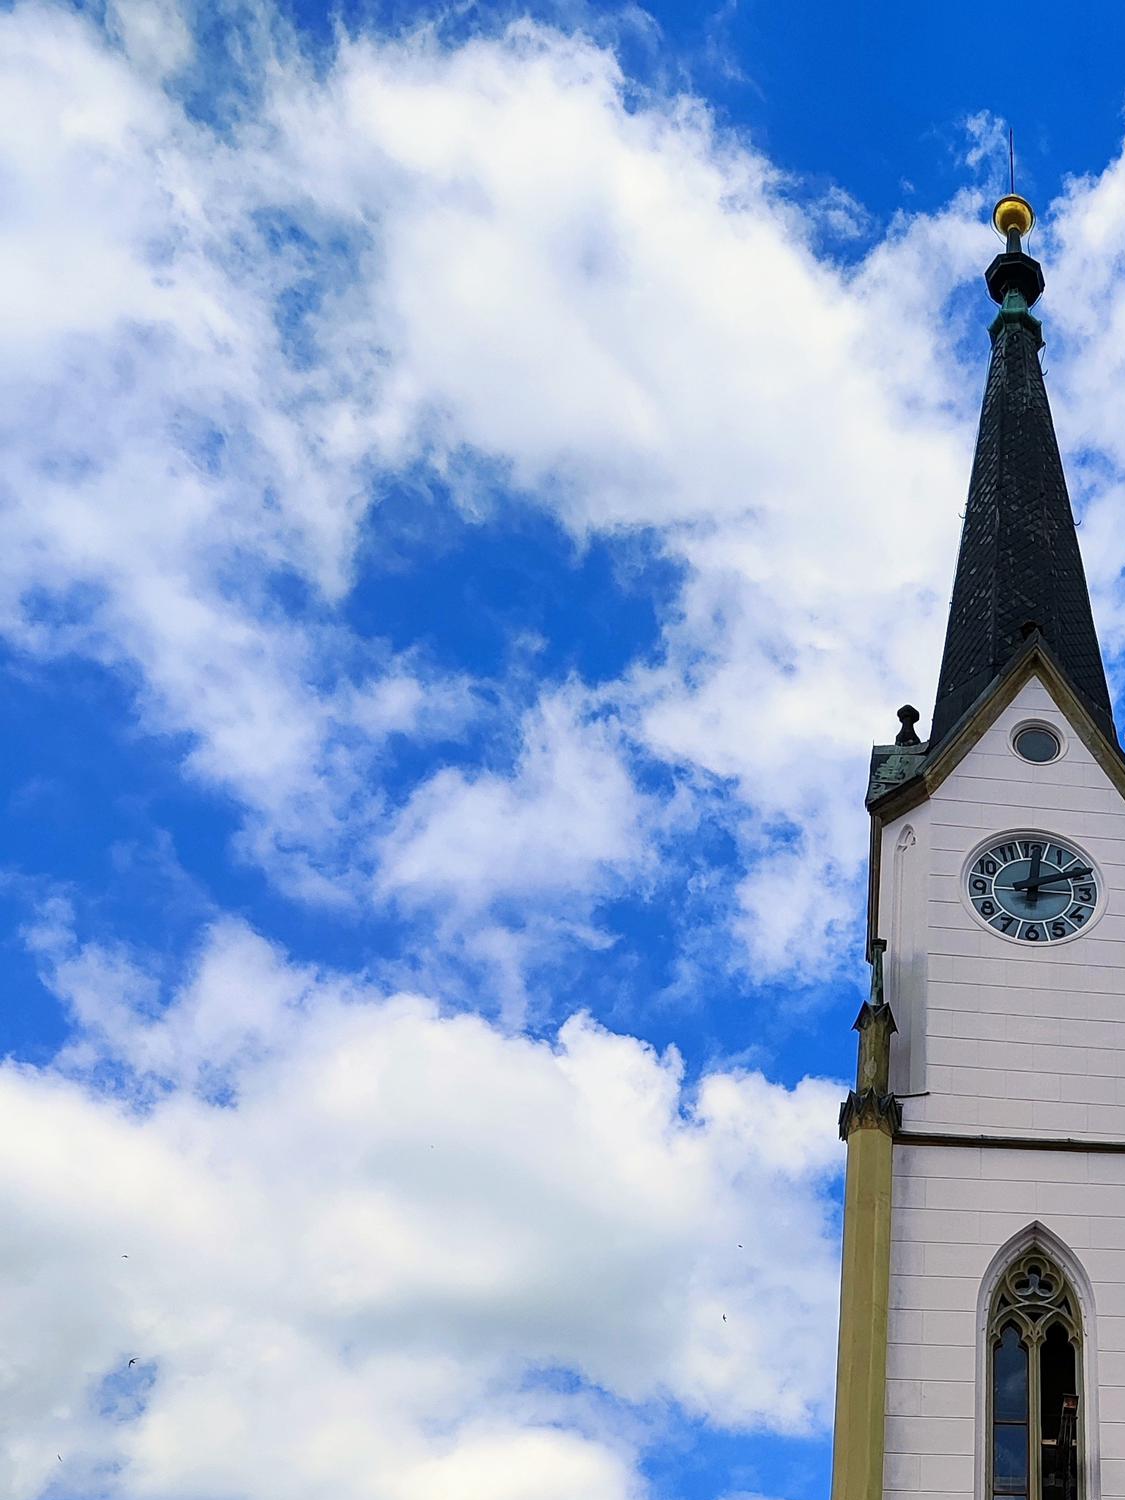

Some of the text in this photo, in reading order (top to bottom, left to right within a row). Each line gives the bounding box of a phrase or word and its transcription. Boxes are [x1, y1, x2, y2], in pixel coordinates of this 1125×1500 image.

[999, 845, 1015, 862] 11
[1056, 849, 1063, 865] 1
[978, 858, 996, 875] 10
[972, 879, 987, 894] 9
[1078, 887, 1092, 902] 3
[980, 900, 995, 915] 8
[1069, 906, 1084, 922] 4
[1000, 916, 1012, 933] 7
[1024, 924, 1040, 941] 6
[1051, 921, 1067, 938] 5
